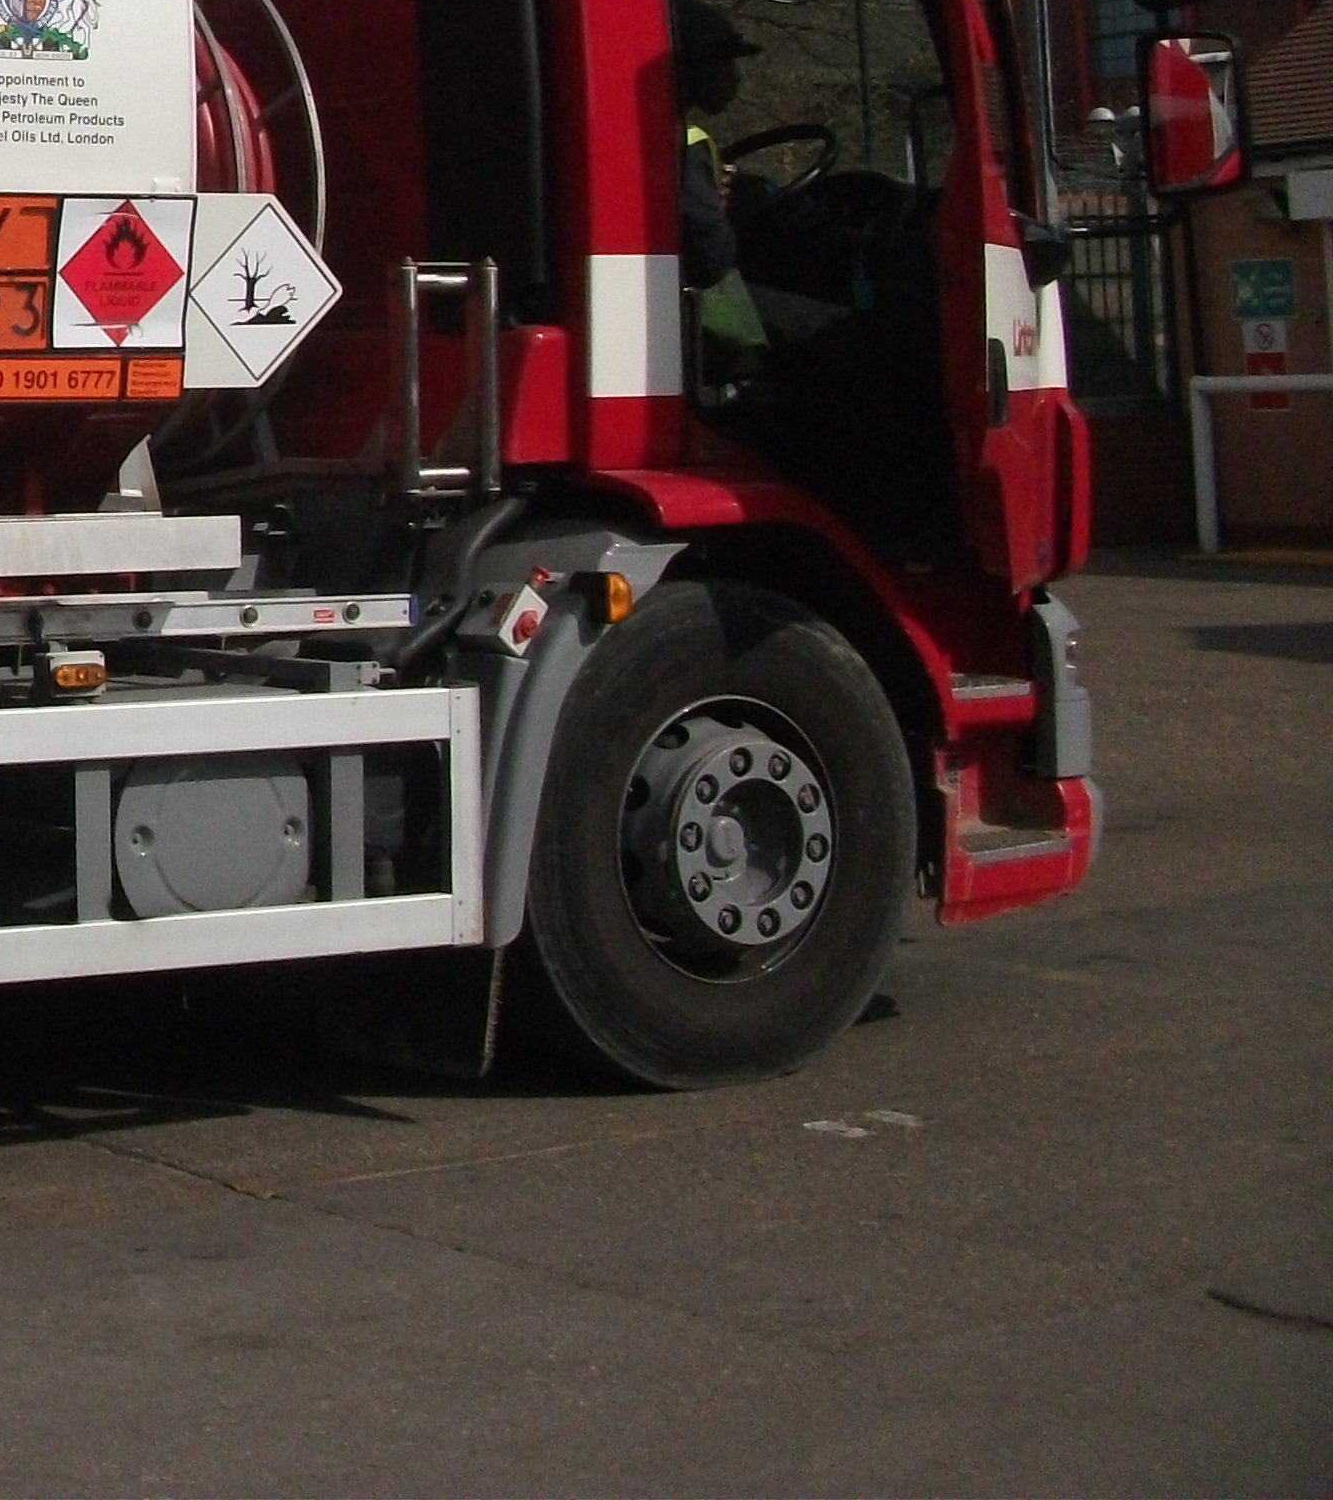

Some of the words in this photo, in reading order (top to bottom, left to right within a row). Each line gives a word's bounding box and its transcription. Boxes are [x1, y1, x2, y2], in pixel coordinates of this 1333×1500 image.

[72, 77, 85, 88] to
[31, 92, 54, 106] The
[58, 93, 98, 107] Queen
[2, 111, 65, 125] Petroleum
[69, 112, 125, 126] Products
[11, 129, 36, 143] Oils
[40, 131, 64, 144] Ltd.
[67, 132, 115, 145] London
[12, 371, 58, 389] 1901
[67, 371, 117, 389] 6777
